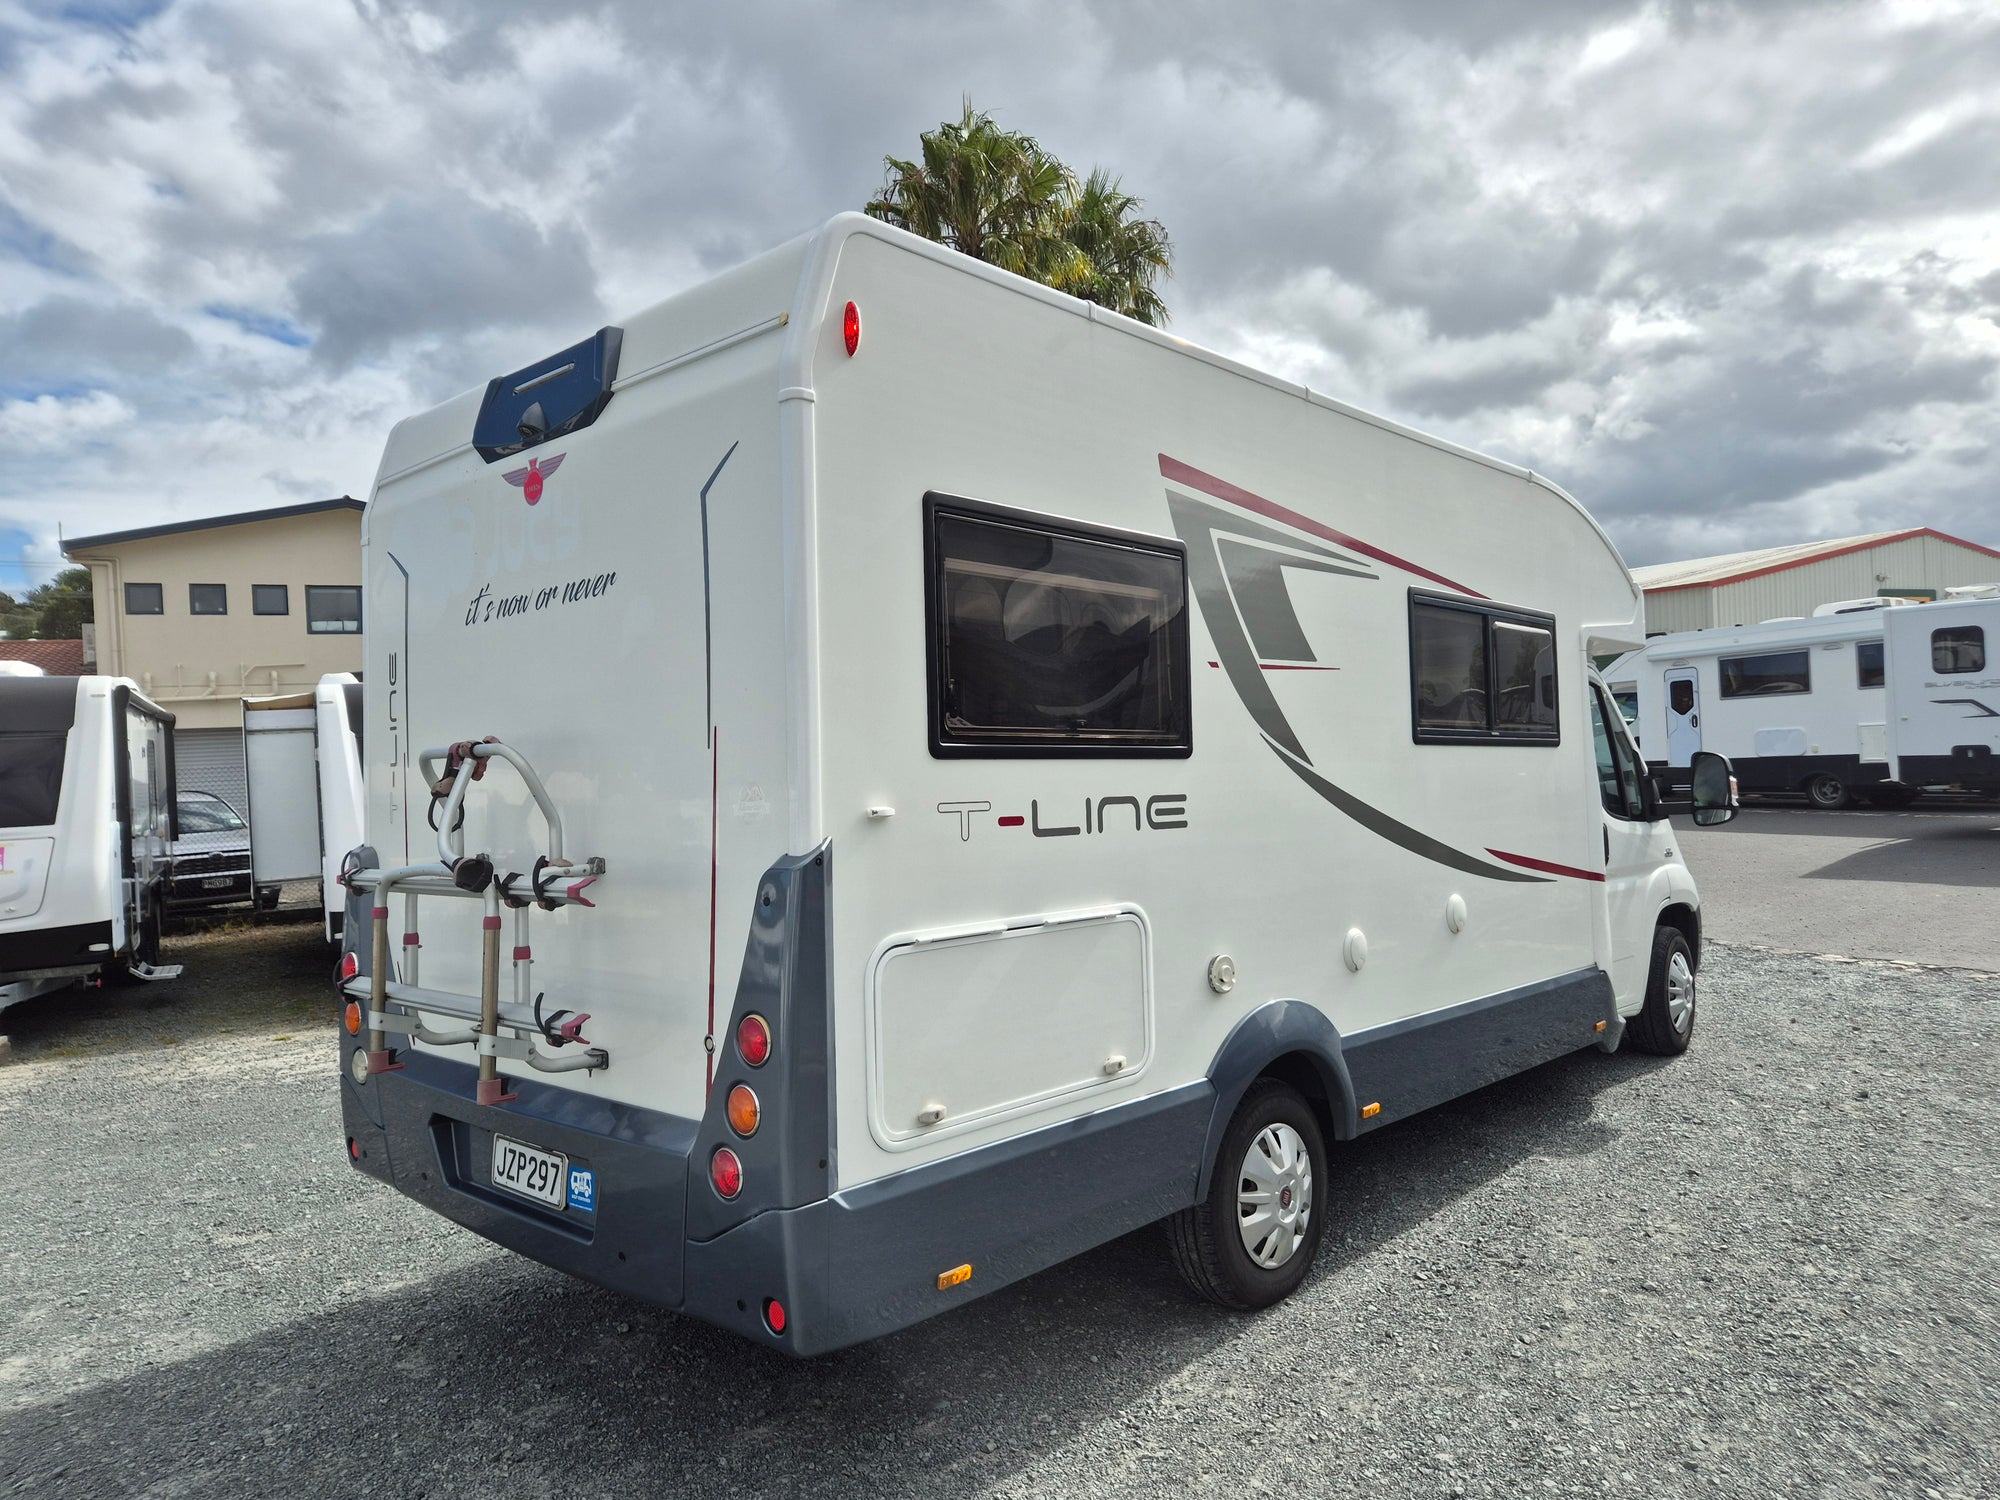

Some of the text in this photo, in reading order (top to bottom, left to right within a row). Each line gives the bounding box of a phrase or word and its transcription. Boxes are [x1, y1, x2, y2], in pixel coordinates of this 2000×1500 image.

[465, 571, 617, 626] it's now or never
[936, 793, 1188, 842] T-LINE
[496, 1146, 560, 1196] JZP297
